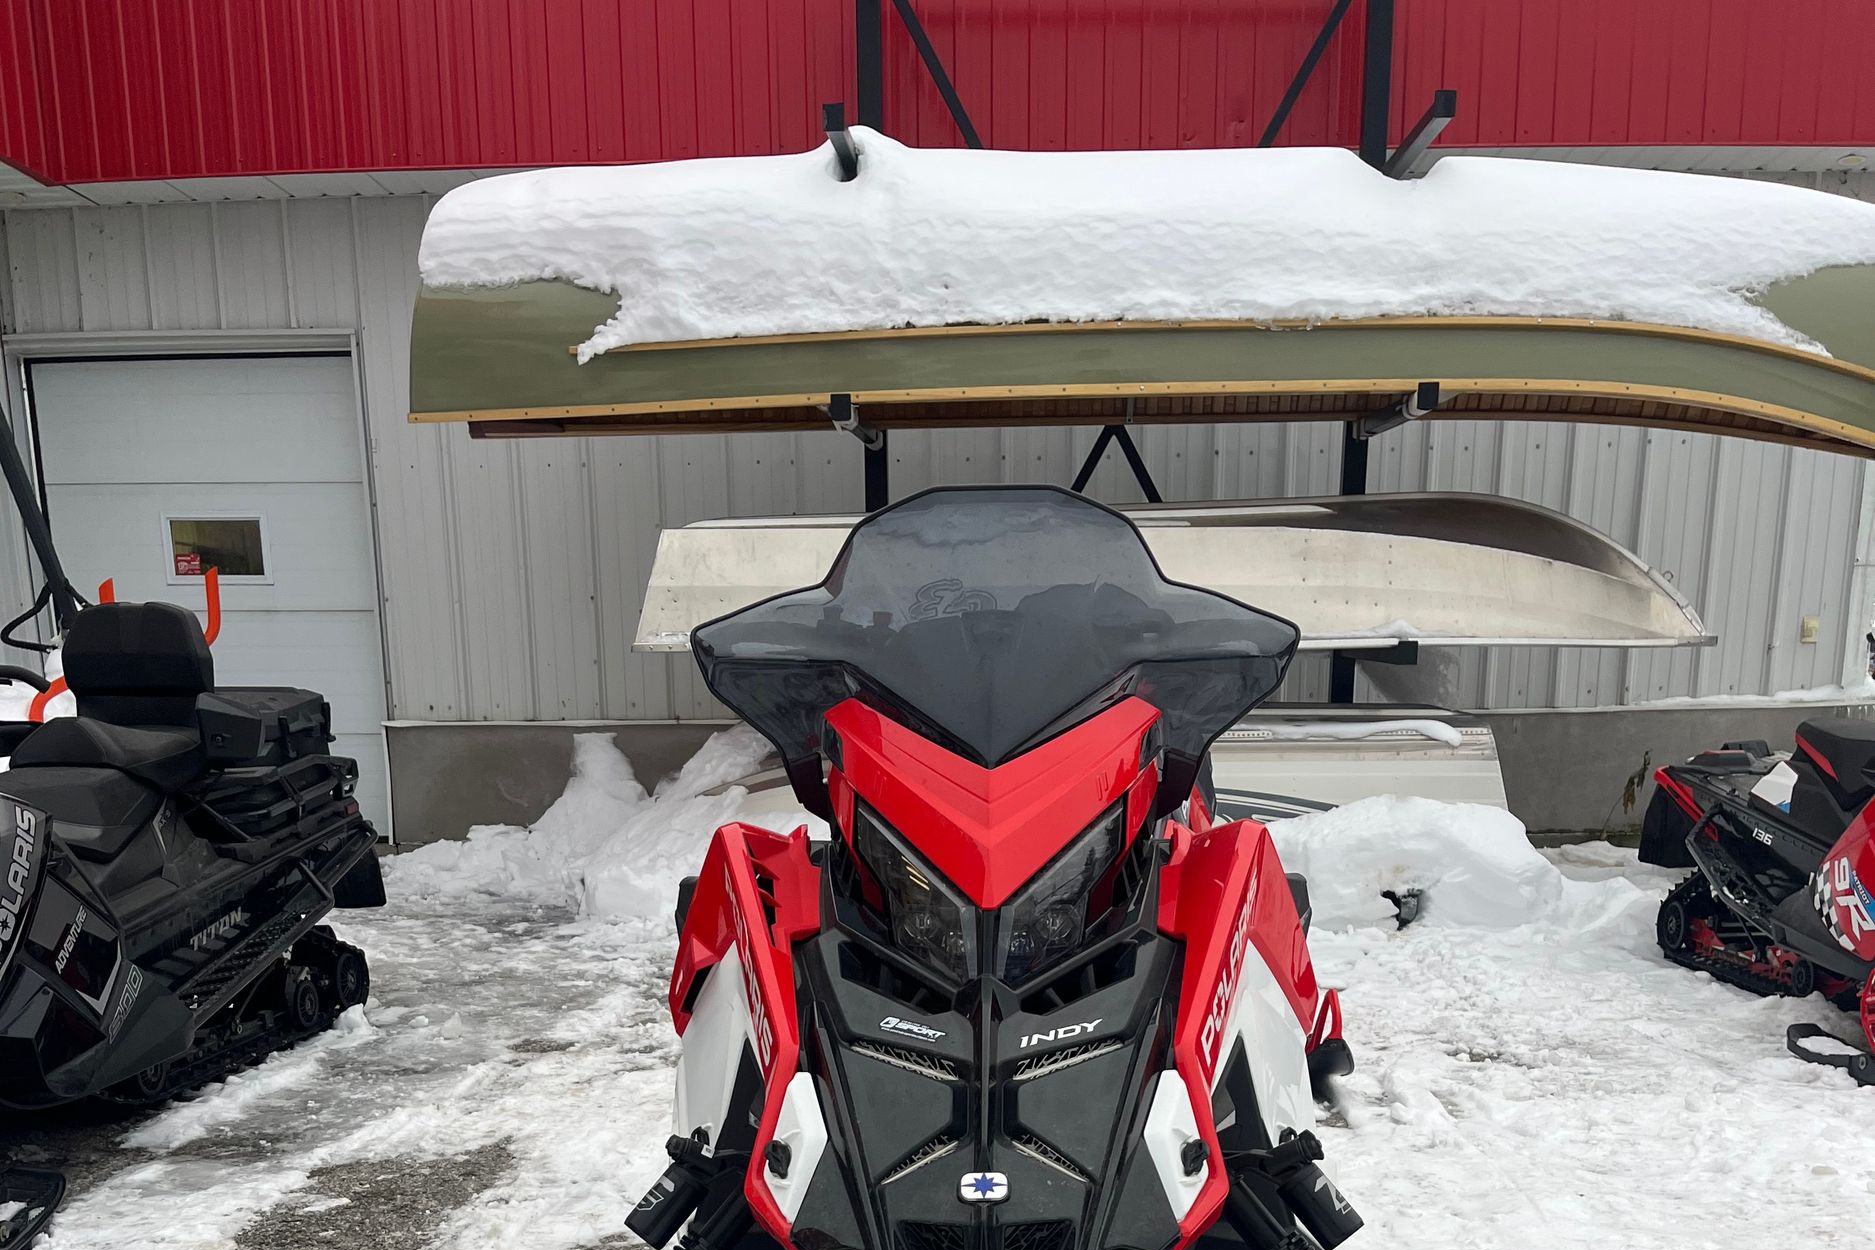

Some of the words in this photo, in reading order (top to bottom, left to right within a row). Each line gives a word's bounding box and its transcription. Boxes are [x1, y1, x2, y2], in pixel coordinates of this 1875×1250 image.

[1752, 827, 1773, 846] 136
[0, 804, 37, 948] OLARIS
[1852, 869, 1870, 905] PATRIOT
[54, 904, 88, 975] ADVENTURE
[190, 905, 242, 952] TITAN
[1200, 868, 1258, 1066] POLARIS
[1020, 1018, 1104, 1049] INDY
